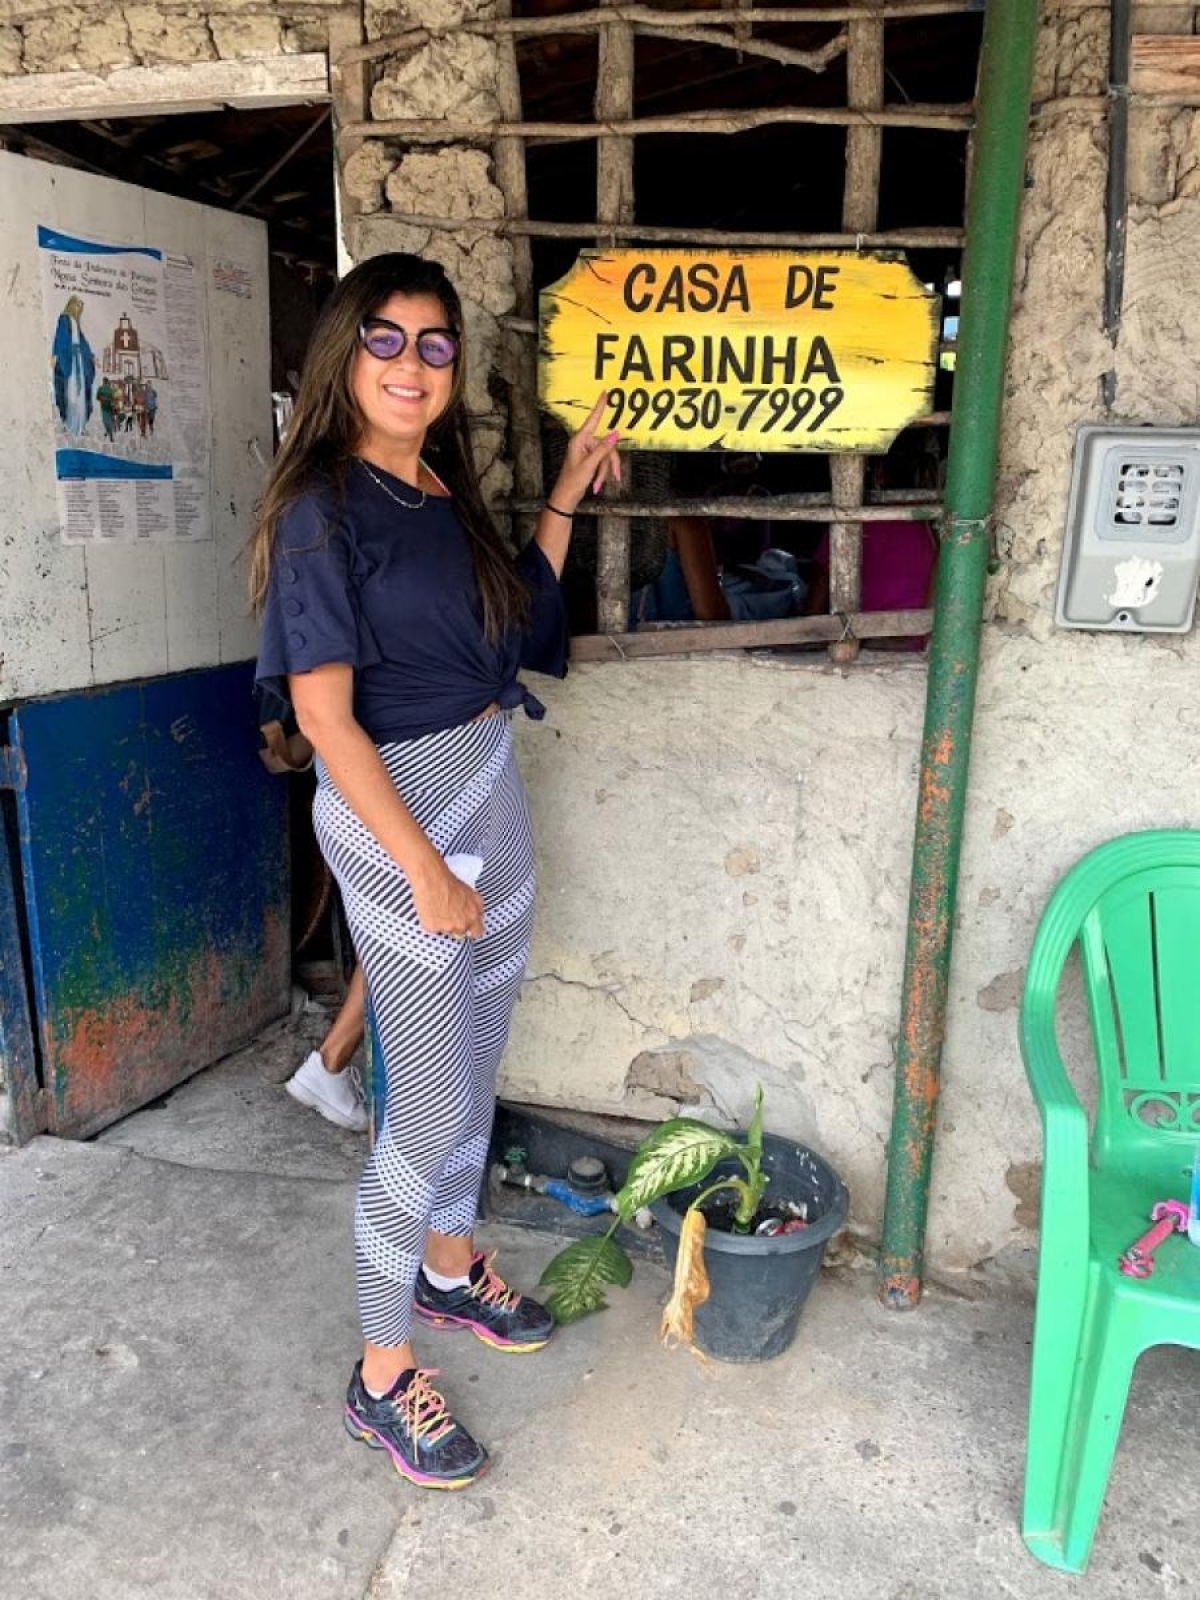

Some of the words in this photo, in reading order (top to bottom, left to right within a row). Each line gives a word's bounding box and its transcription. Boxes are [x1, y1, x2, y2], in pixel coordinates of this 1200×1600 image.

[623, 263, 750, 313] CASA
[785, 265, 841, 309] DE
[594, 333, 841, 384] FARINHA
[604, 387, 844, 433] 99930-7999
